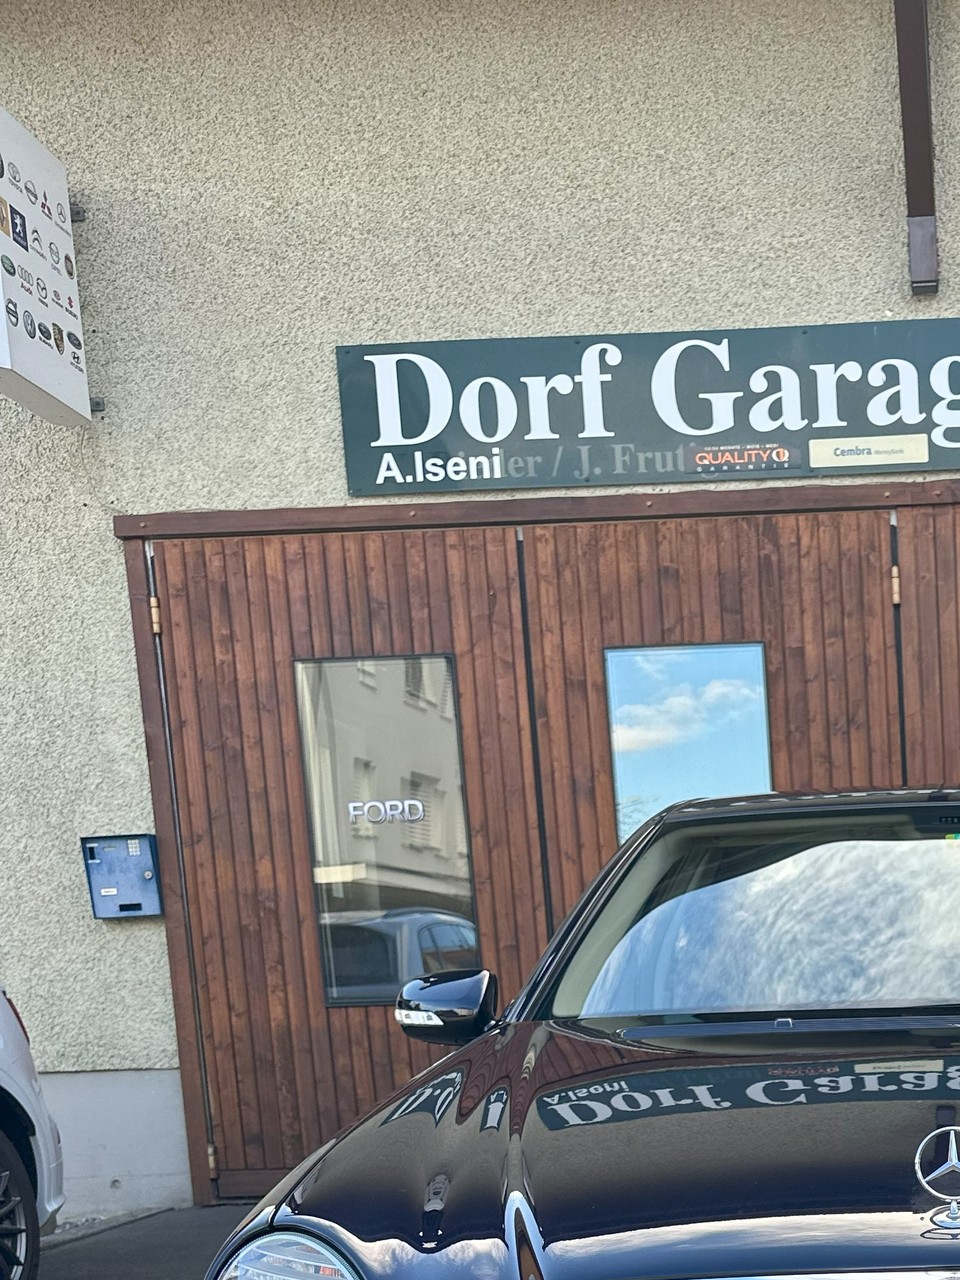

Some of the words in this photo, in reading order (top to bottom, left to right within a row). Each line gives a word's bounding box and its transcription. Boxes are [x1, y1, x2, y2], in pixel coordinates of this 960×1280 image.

[363, 341, 623, 448] Dorf
[375, 447, 501, 485] A.Iseni
[611, 442, 697, 475] Frut
[695, 449, 771, 465] QUALITY
[833, 446, 872, 457] Cembra
[347, 798, 425, 825] FORD
